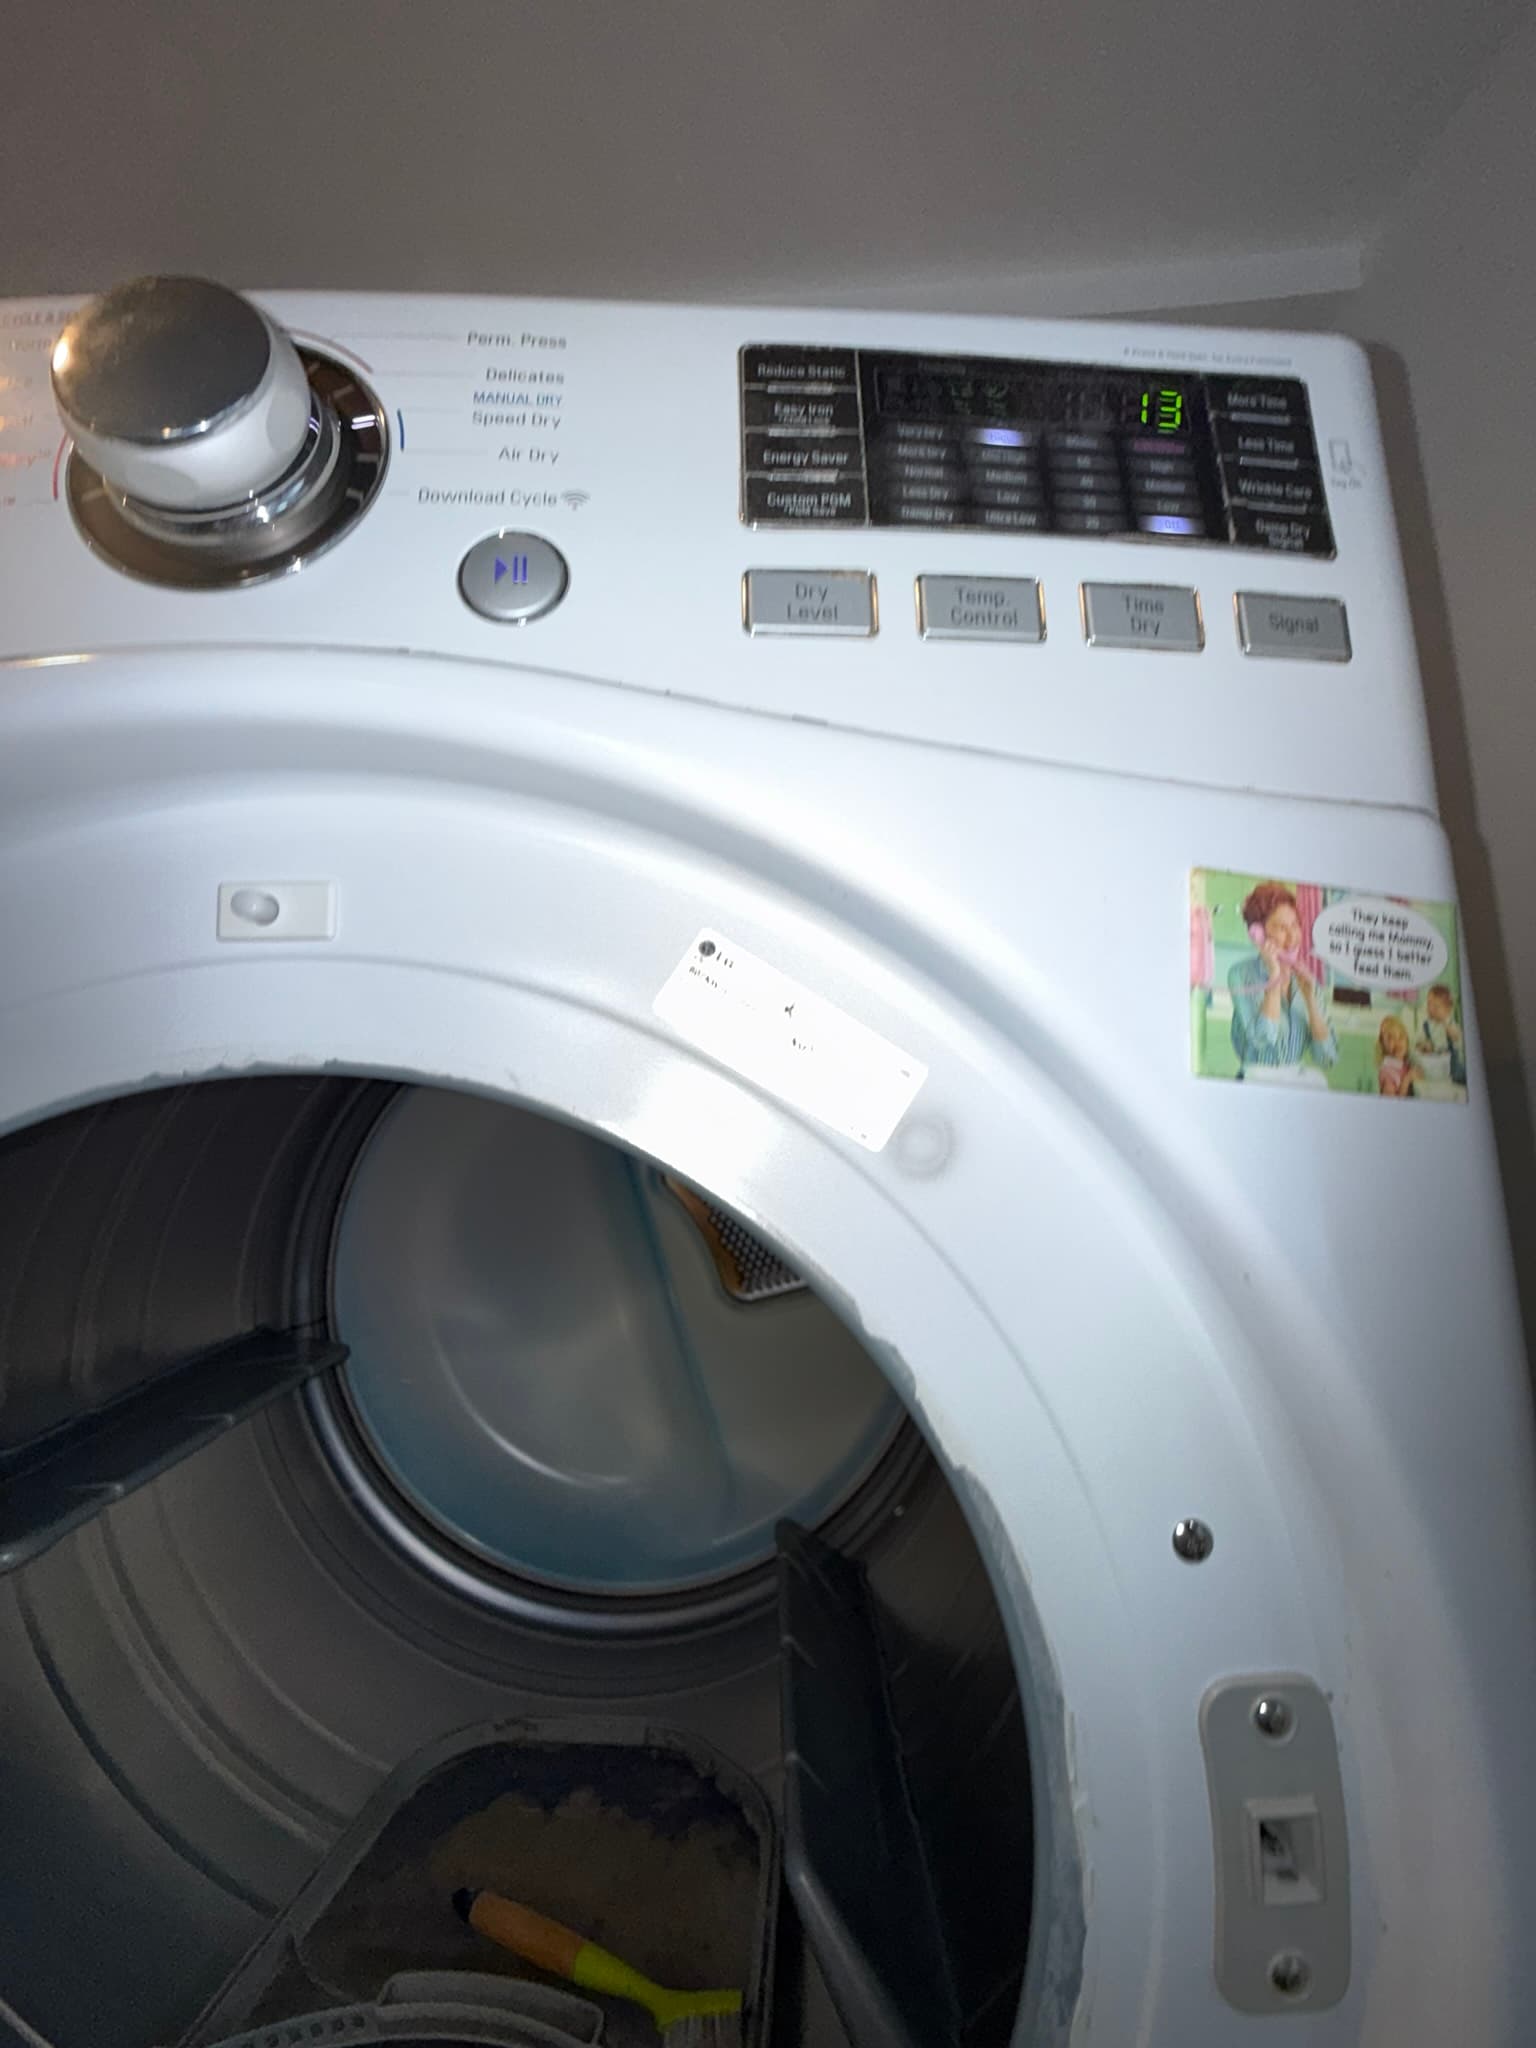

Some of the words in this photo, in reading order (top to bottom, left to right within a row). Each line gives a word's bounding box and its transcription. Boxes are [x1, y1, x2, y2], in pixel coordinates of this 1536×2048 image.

[520, 332, 567, 348] Press
[485, 366, 564, 384] Delicates
[757, 362, 805, 377] Reduce
[808, 365, 846, 378] Static
[473, 390, 533, 405] MANUAL
[536, 393, 563, 408] DRY
[472, 410, 526, 427] Speed
[531, 412, 562, 430] Dry
[774, 402, 806, 418] Easy
[498, 445, 521, 462] Air
[529, 448, 559, 466] Dry
[763, 449, 809, 467] Energy
[812, 450, 849, 465] Saver
[418, 487, 505, 505] Download
[510, 489, 557, 509] Cycle
[767, 491, 818, 507] Custom
[821, 493, 851, 508] PGM
[794, 582, 829, 603] Dry
[956, 585, 1010, 608] Temp.
[786, 602, 839, 622] Level
[1123, 594, 1165, 614] Time
[950, 607, 1019, 627] Control
[1130, 617, 1161, 637] Dry
[1268, 612, 1319, 634] Signal
[1352, 907, 1379, 926] They
